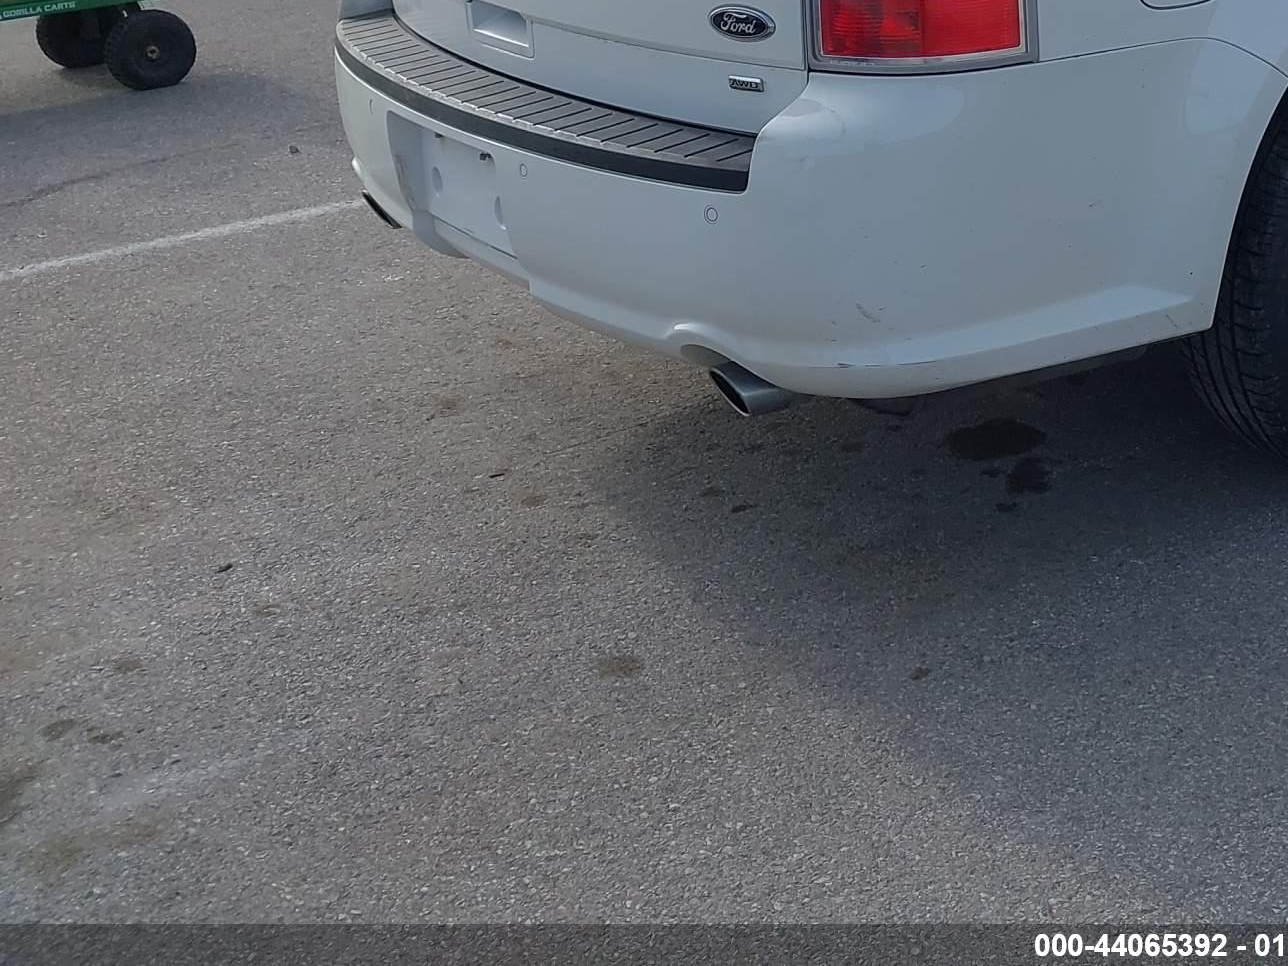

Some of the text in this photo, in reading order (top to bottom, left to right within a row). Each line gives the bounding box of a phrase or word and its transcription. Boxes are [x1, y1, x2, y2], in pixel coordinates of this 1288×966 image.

[44, 1, 76, 12] CARTS
[720, 12, 757, 34] Ford
[730, 78, 759, 90] AWD
